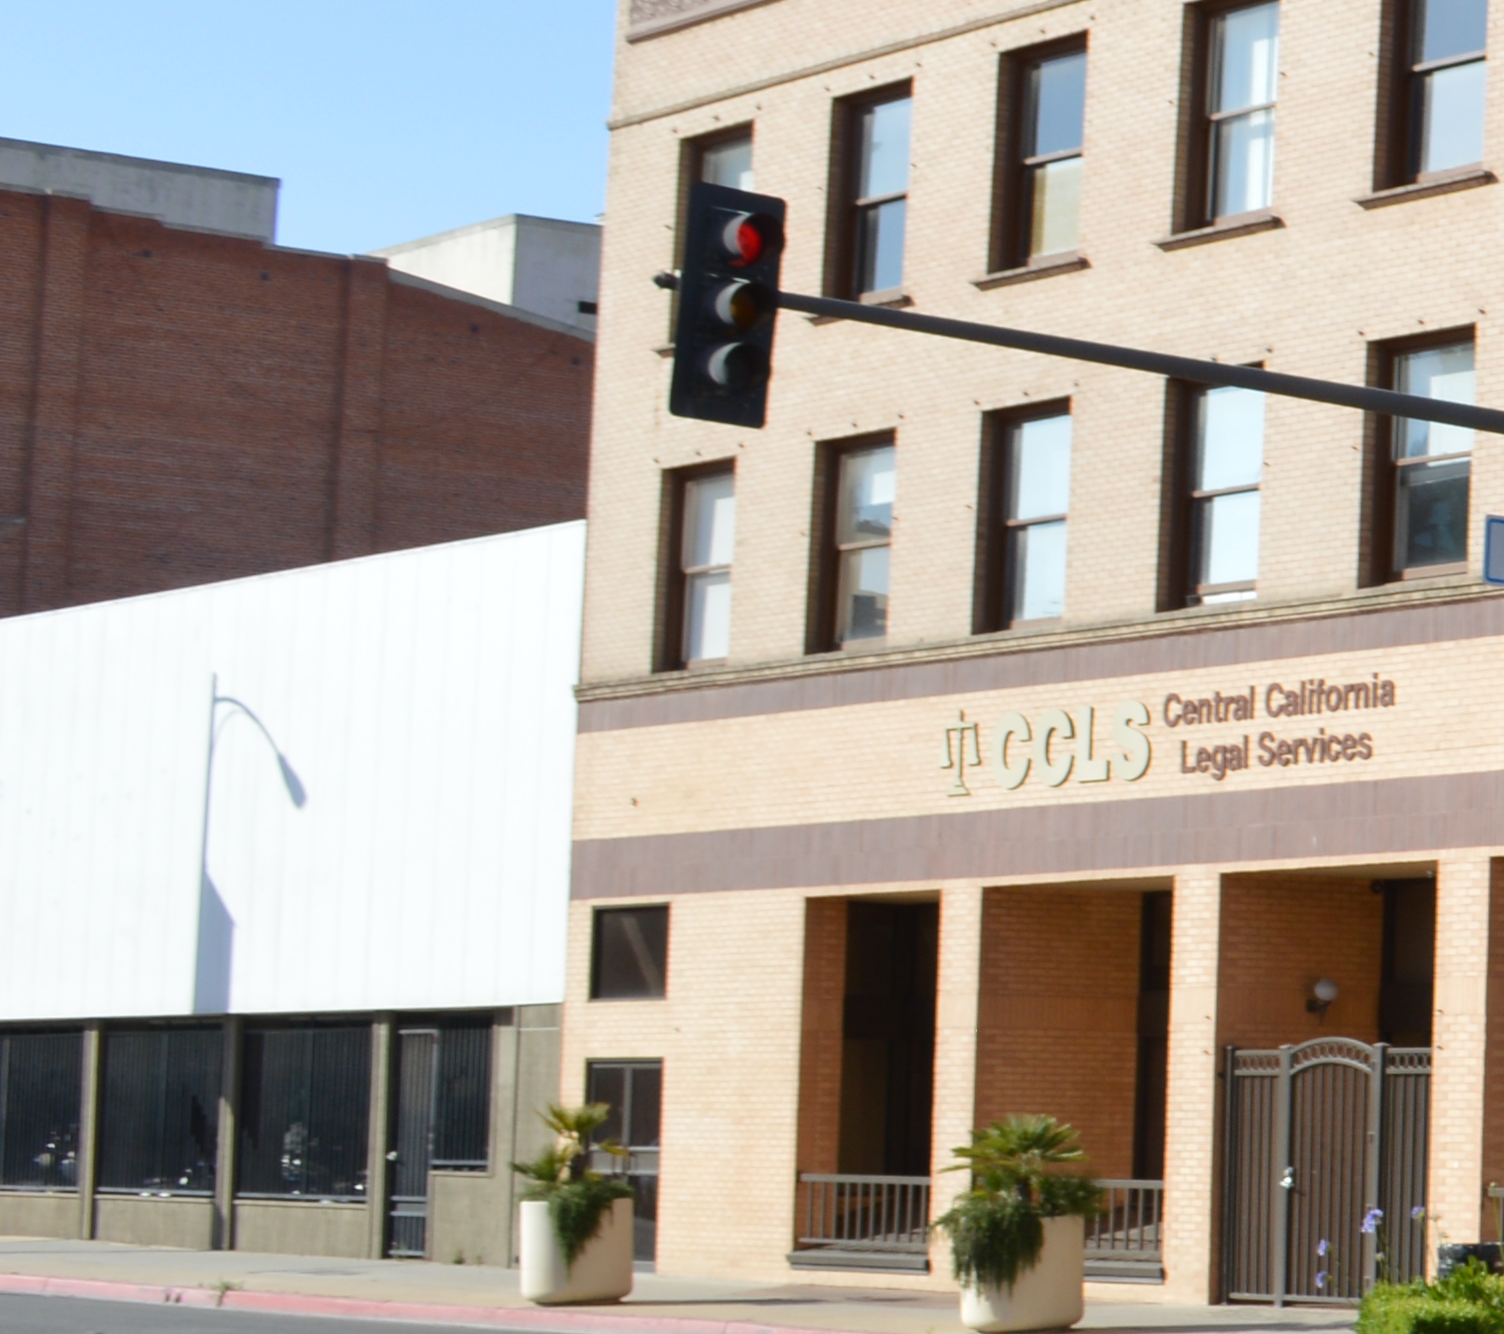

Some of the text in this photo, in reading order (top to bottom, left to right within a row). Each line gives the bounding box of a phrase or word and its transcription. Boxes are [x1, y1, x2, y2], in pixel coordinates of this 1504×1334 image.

[1163, 672, 1396, 728] Central California
[992, 699, 1151, 791] CCLS
[1180, 727, 1374, 781] Legal Services
